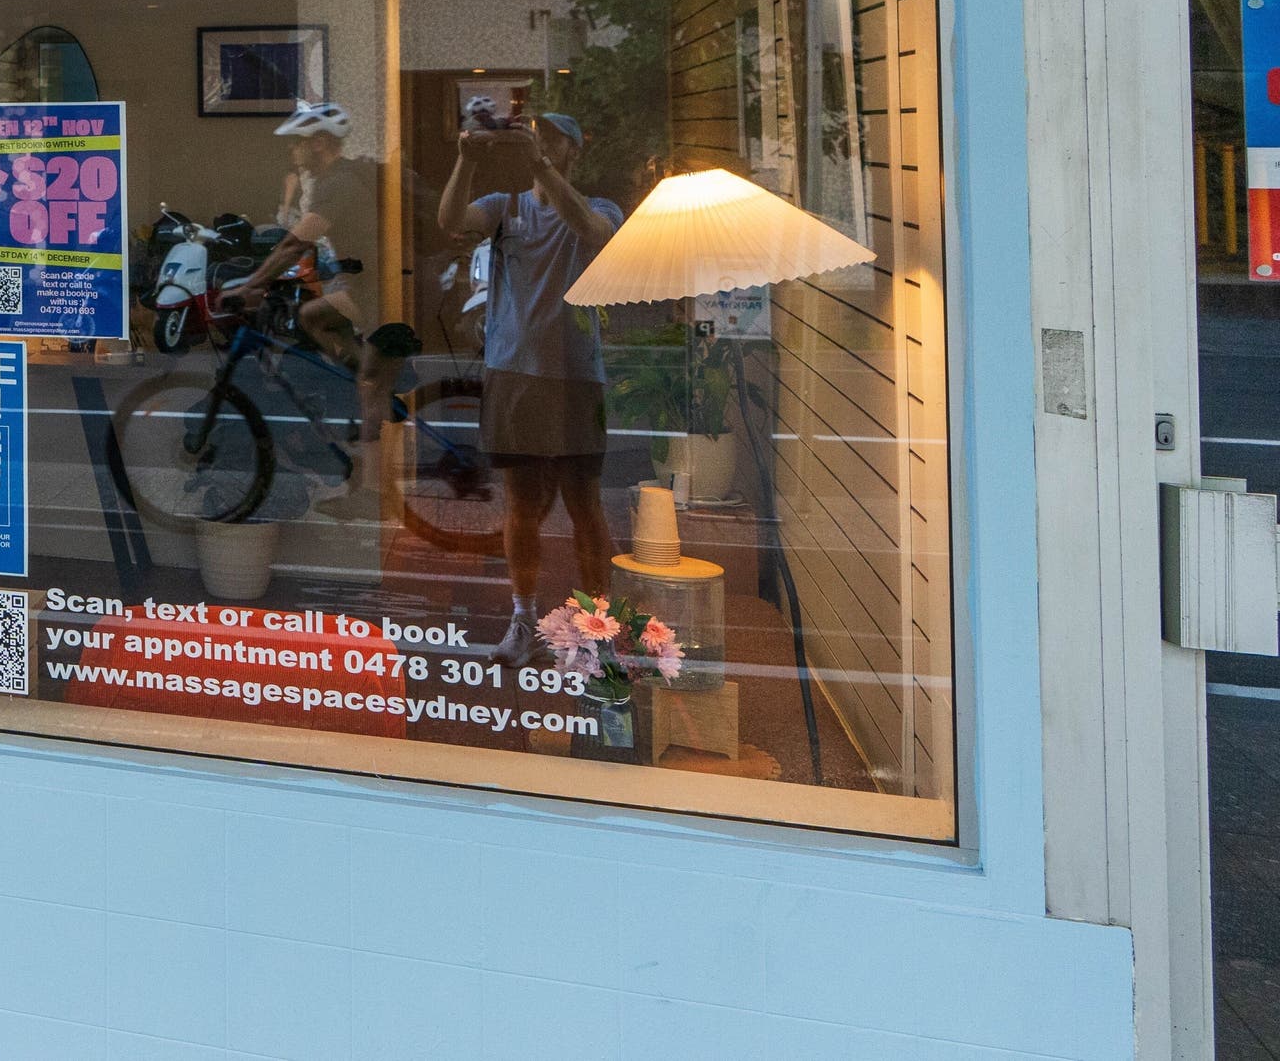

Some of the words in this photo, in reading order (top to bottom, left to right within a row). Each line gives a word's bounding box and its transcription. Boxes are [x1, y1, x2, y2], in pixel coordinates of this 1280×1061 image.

[62, 119, 104, 136] NOV
[16, 141, 52, 150] BOOKING
[53, 140, 74, 149] WITH
[74, 140, 86, 148] US
[12, 156, 118, 200] $20
[10, 200, 108, 244] OFF
[11, 251, 28, 260] DAY
[47, 254, 90, 264] DECEMBER
[40, 272, 60, 280] Scan
[62, 272, 73, 280] QR
[63, 290, 98, 299] booking
[40, 306, 62, 314] 0478
[46, 587, 134, 622] Scan,
[143, 597, 209, 626] text
[219, 604, 254, 629] or
[262, 604, 324, 634] call
[335, 612, 370, 638] to
[381, 616, 468, 649] book
[45, 624, 114, 652] your
[123, 630, 333, 672] appointment
[343, 649, 429, 680] 0478
[441, 659, 502, 689] 301
[518, 665, 587, 697] 693
[46, 658, 599, 737] www.massagespacesydney.com
